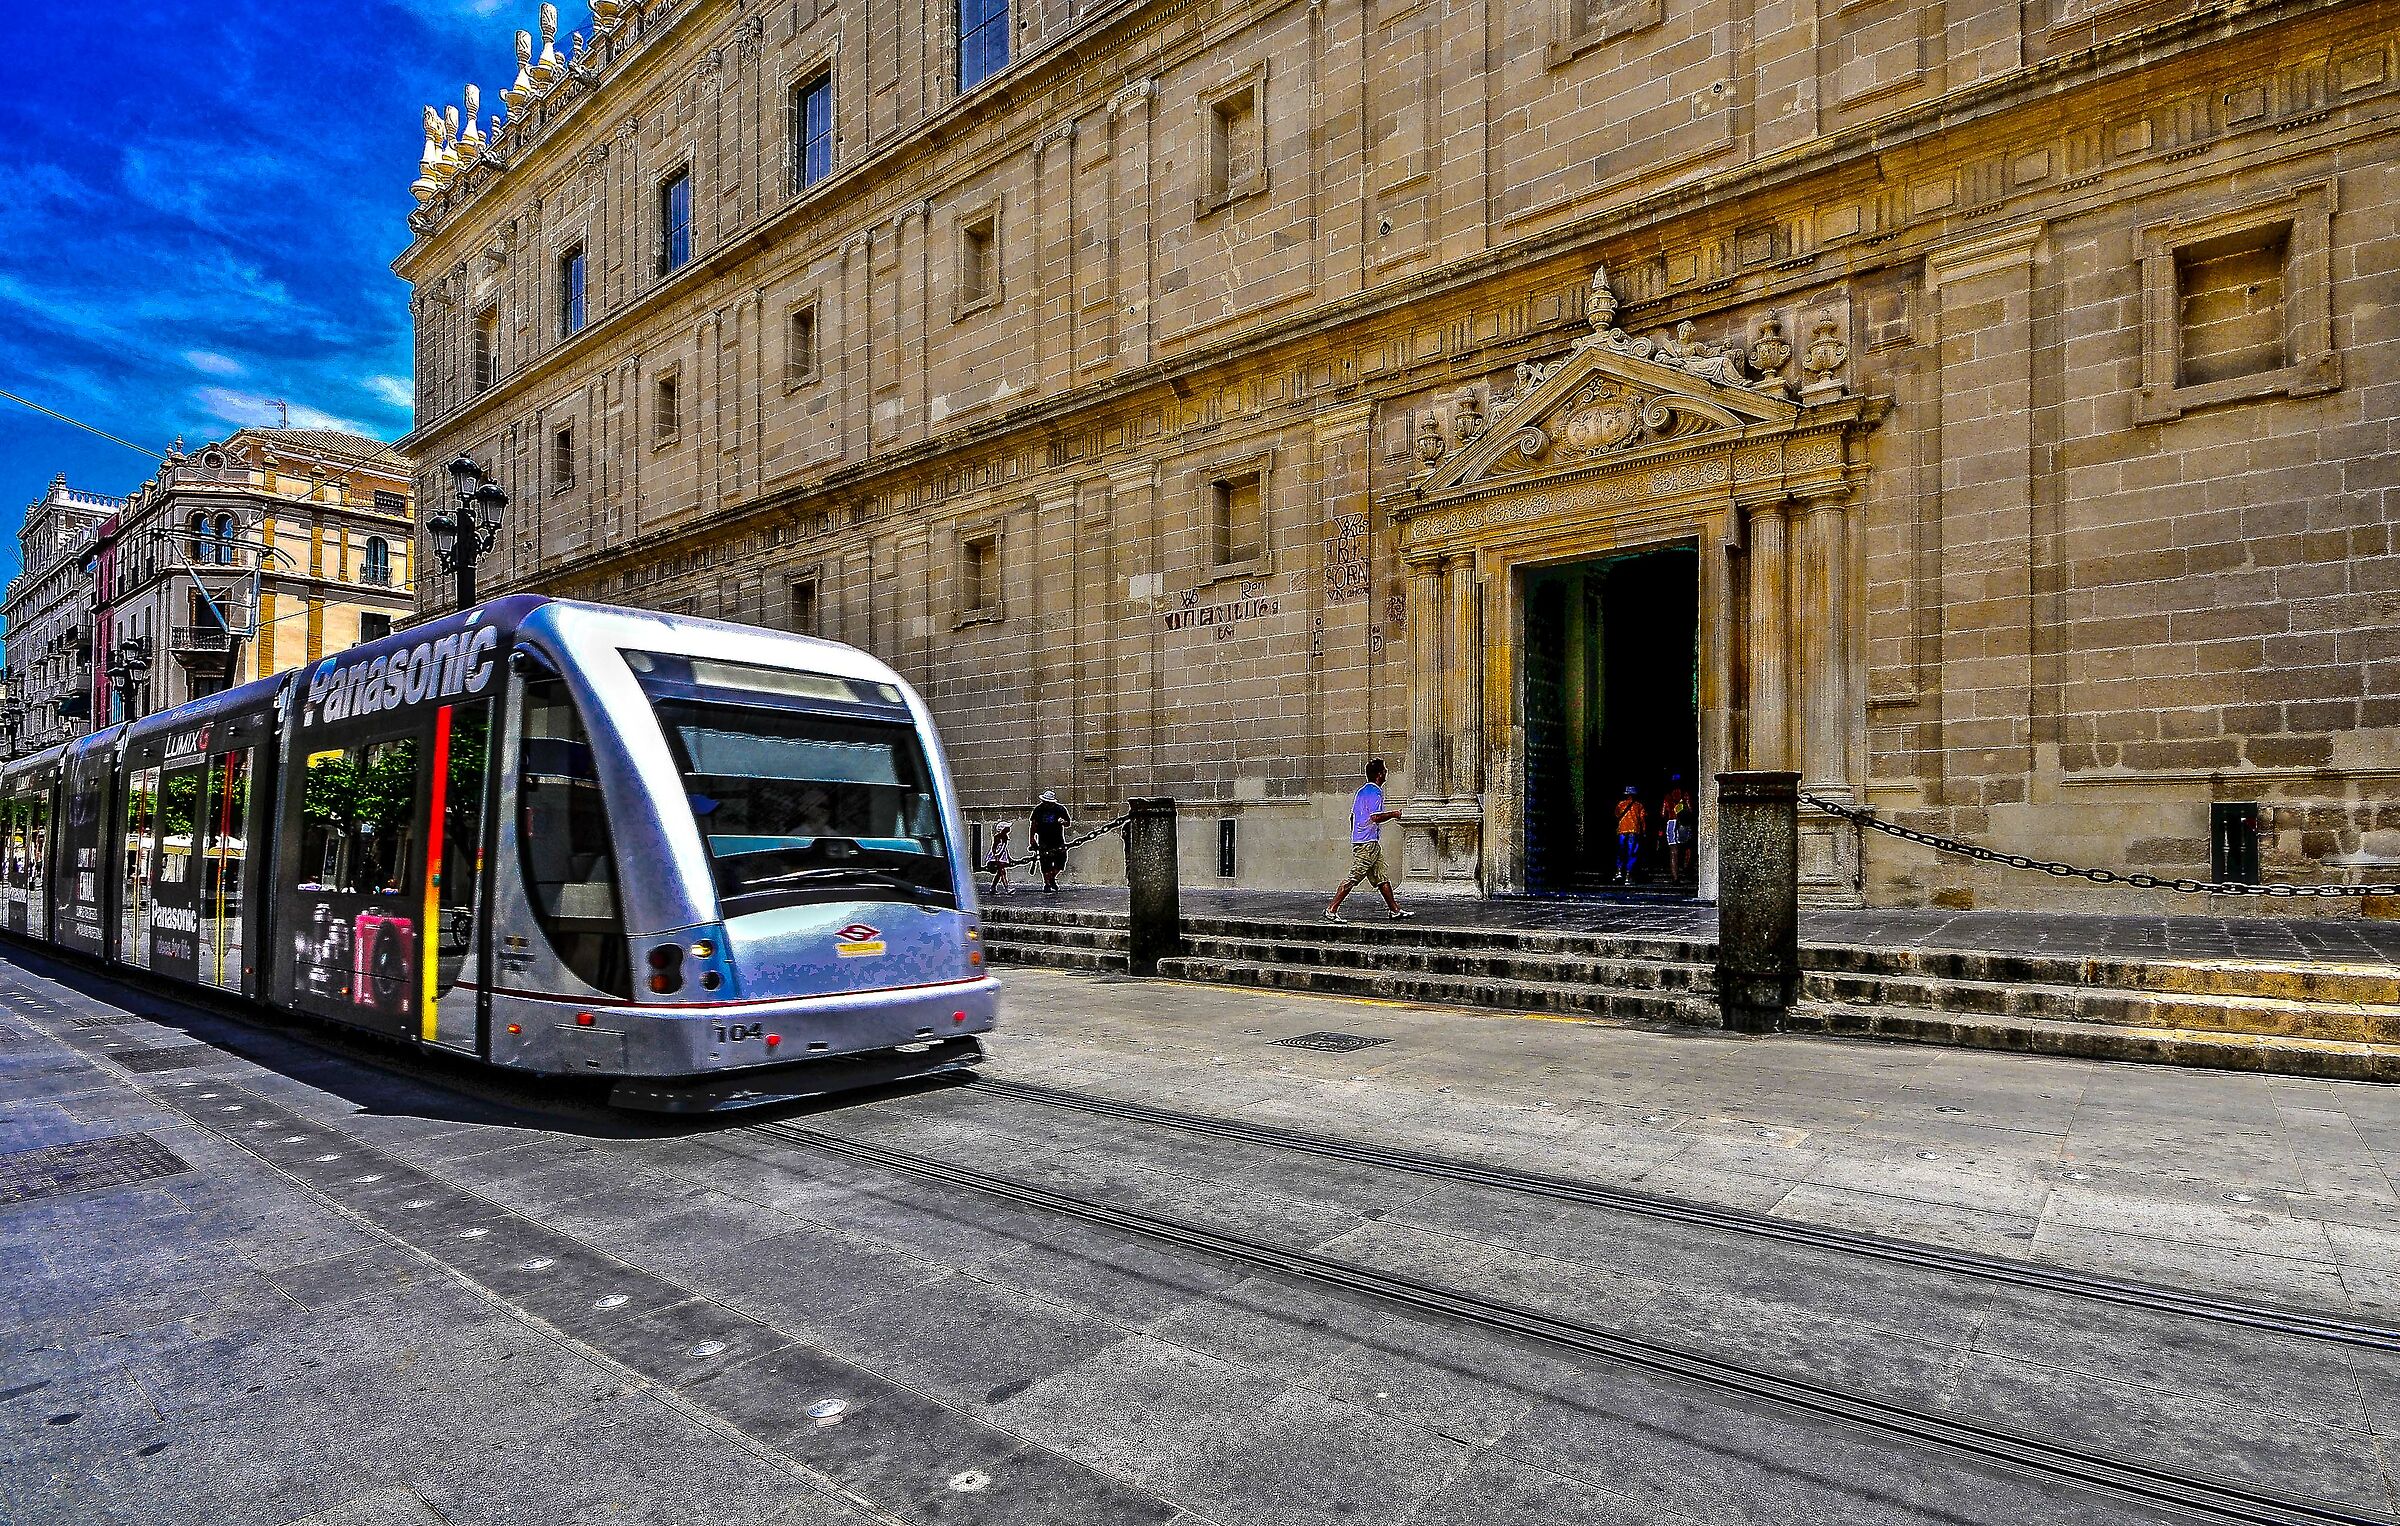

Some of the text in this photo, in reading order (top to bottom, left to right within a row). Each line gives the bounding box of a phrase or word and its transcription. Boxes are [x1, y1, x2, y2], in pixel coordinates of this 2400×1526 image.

[303, 610, 498, 727] Panasonic
[164, 731, 200, 759] LUMIX
[151, 898, 197, 933] Panasonic
[713, 1022, 763, 1044] 104
